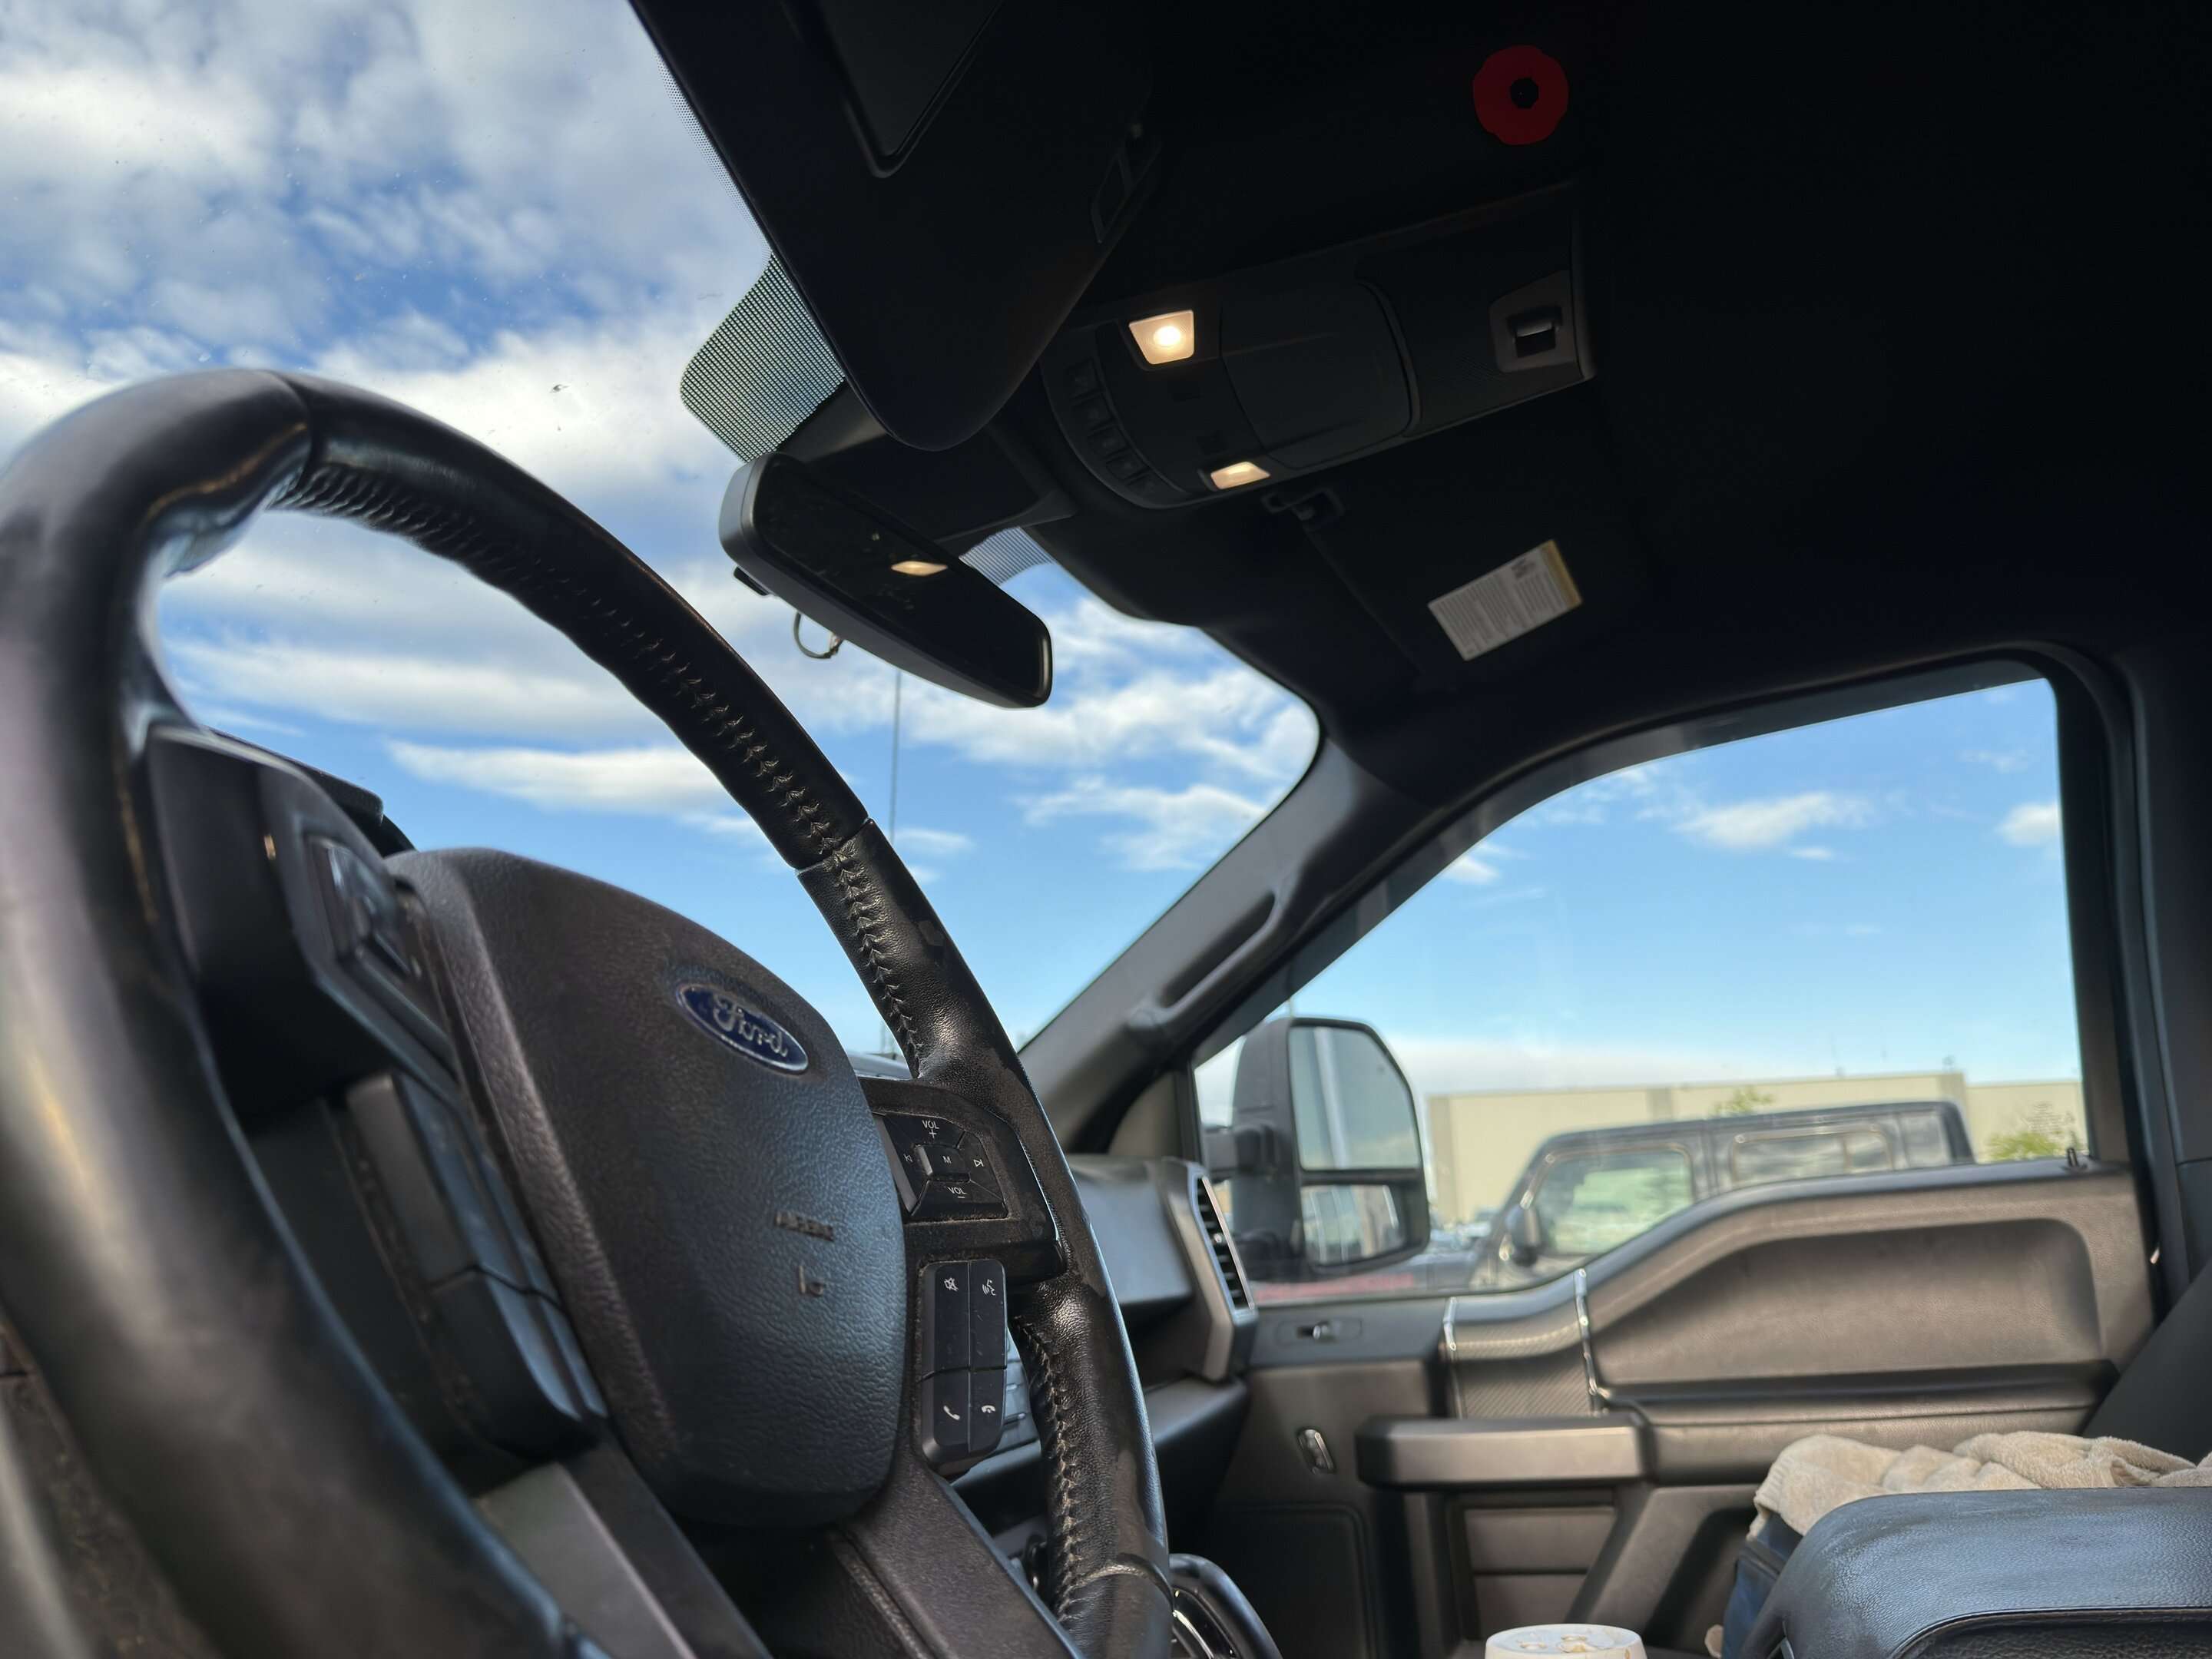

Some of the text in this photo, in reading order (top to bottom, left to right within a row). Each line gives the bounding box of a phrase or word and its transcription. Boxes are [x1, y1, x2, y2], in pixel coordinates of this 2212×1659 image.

[714, 994, 788, 1057] Ford
[922, 1119, 940, 1130] VOL
[942, 1155, 952, 1164] M
[947, 1186, 967, 1194] VOL
